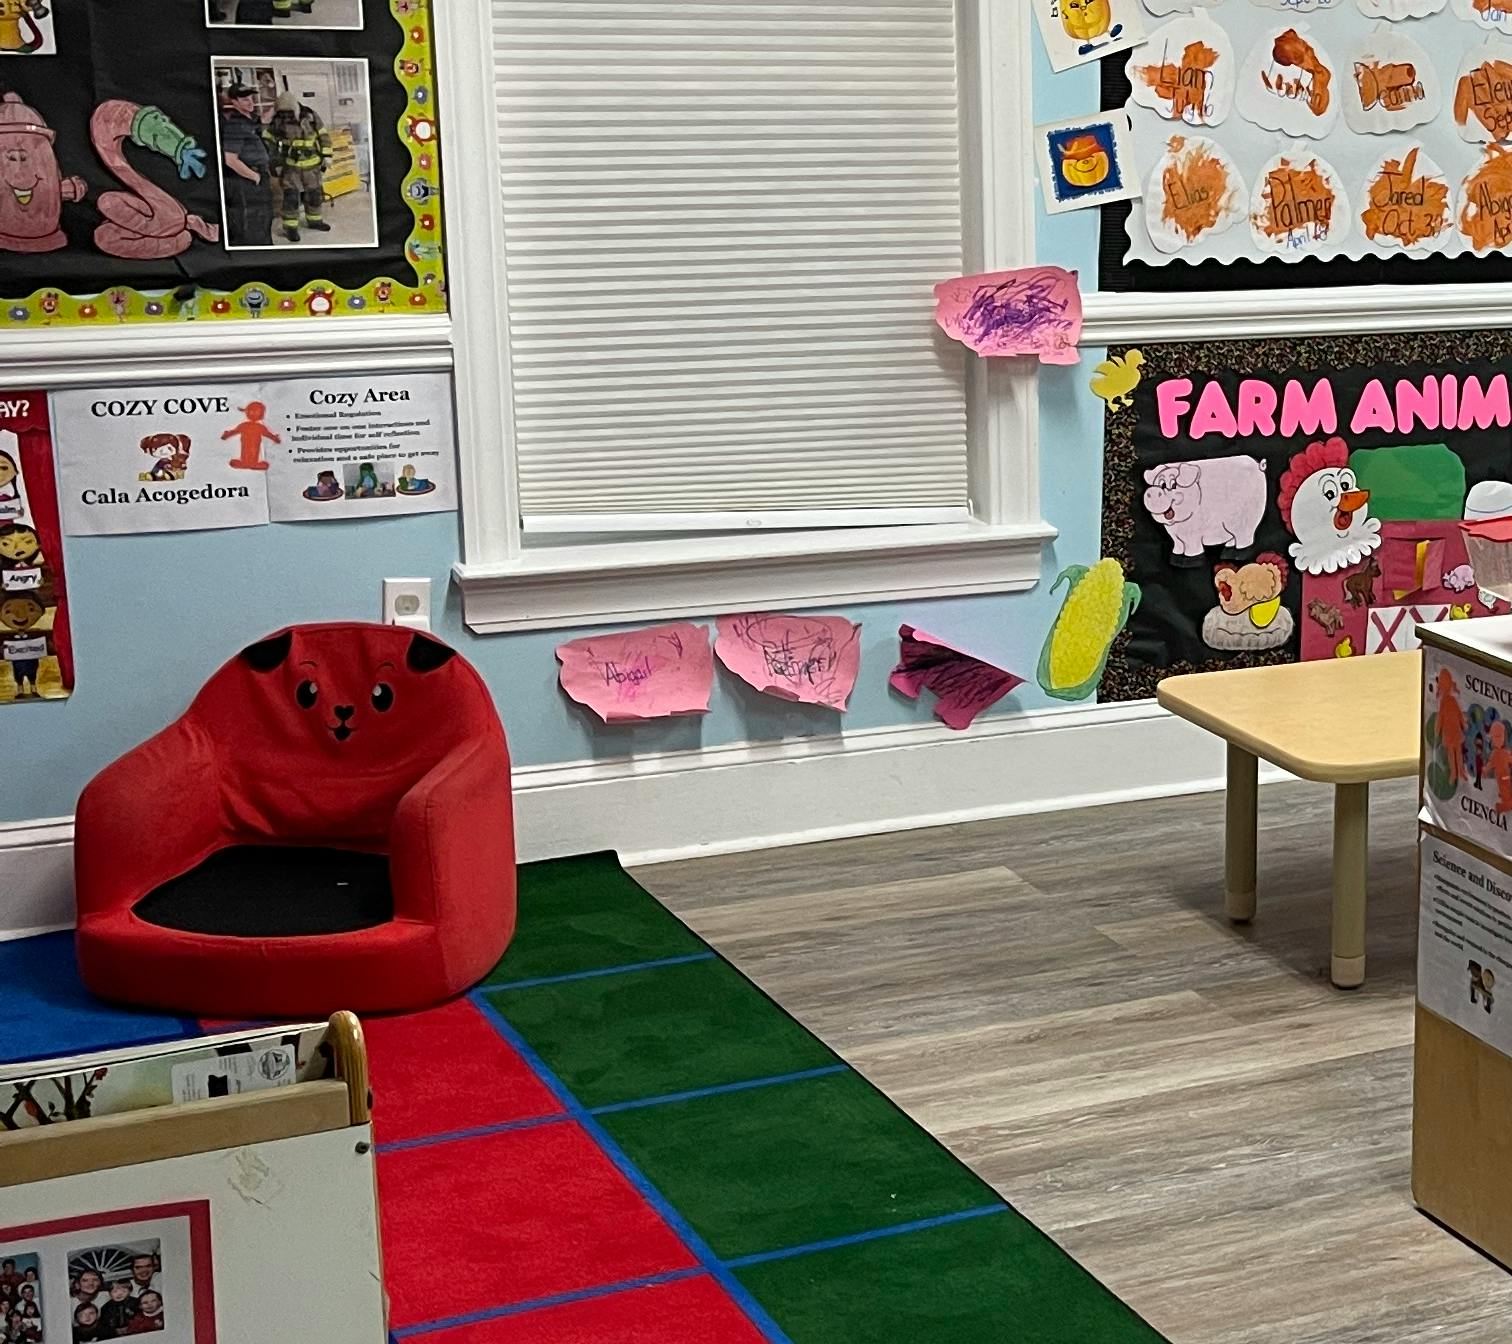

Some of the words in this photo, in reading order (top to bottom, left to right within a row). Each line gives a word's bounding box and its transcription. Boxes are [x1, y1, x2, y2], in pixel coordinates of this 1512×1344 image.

[1159, 37, 1215, 90] Liam
[1168, 179, 1209, 210] Elias
[1269, 172, 1332, 229] Palmer
[1373, 170, 1425, 208] Jared
[1382, 208, 1417, 237] Oct
[91, 399, 157, 417] COZY
[163, 396, 230, 416] COVE
[309, 389, 359, 407] Cozy
[363, 387, 411, 403] Area
[1156, 377, 1337, 439] FARM
[338, 410, 382, 419] Regulation
[81, 488, 130, 505] Cala
[135, 483, 249, 505] Acogedora
[9, 574, 37, 584] Angry
[603, 654, 652, 687] Abigail
[1461, 795, 1508, 831] CIENCIA
[1432, 849, 1467, 879] Science
[1468, 872, 1485, 889] and
